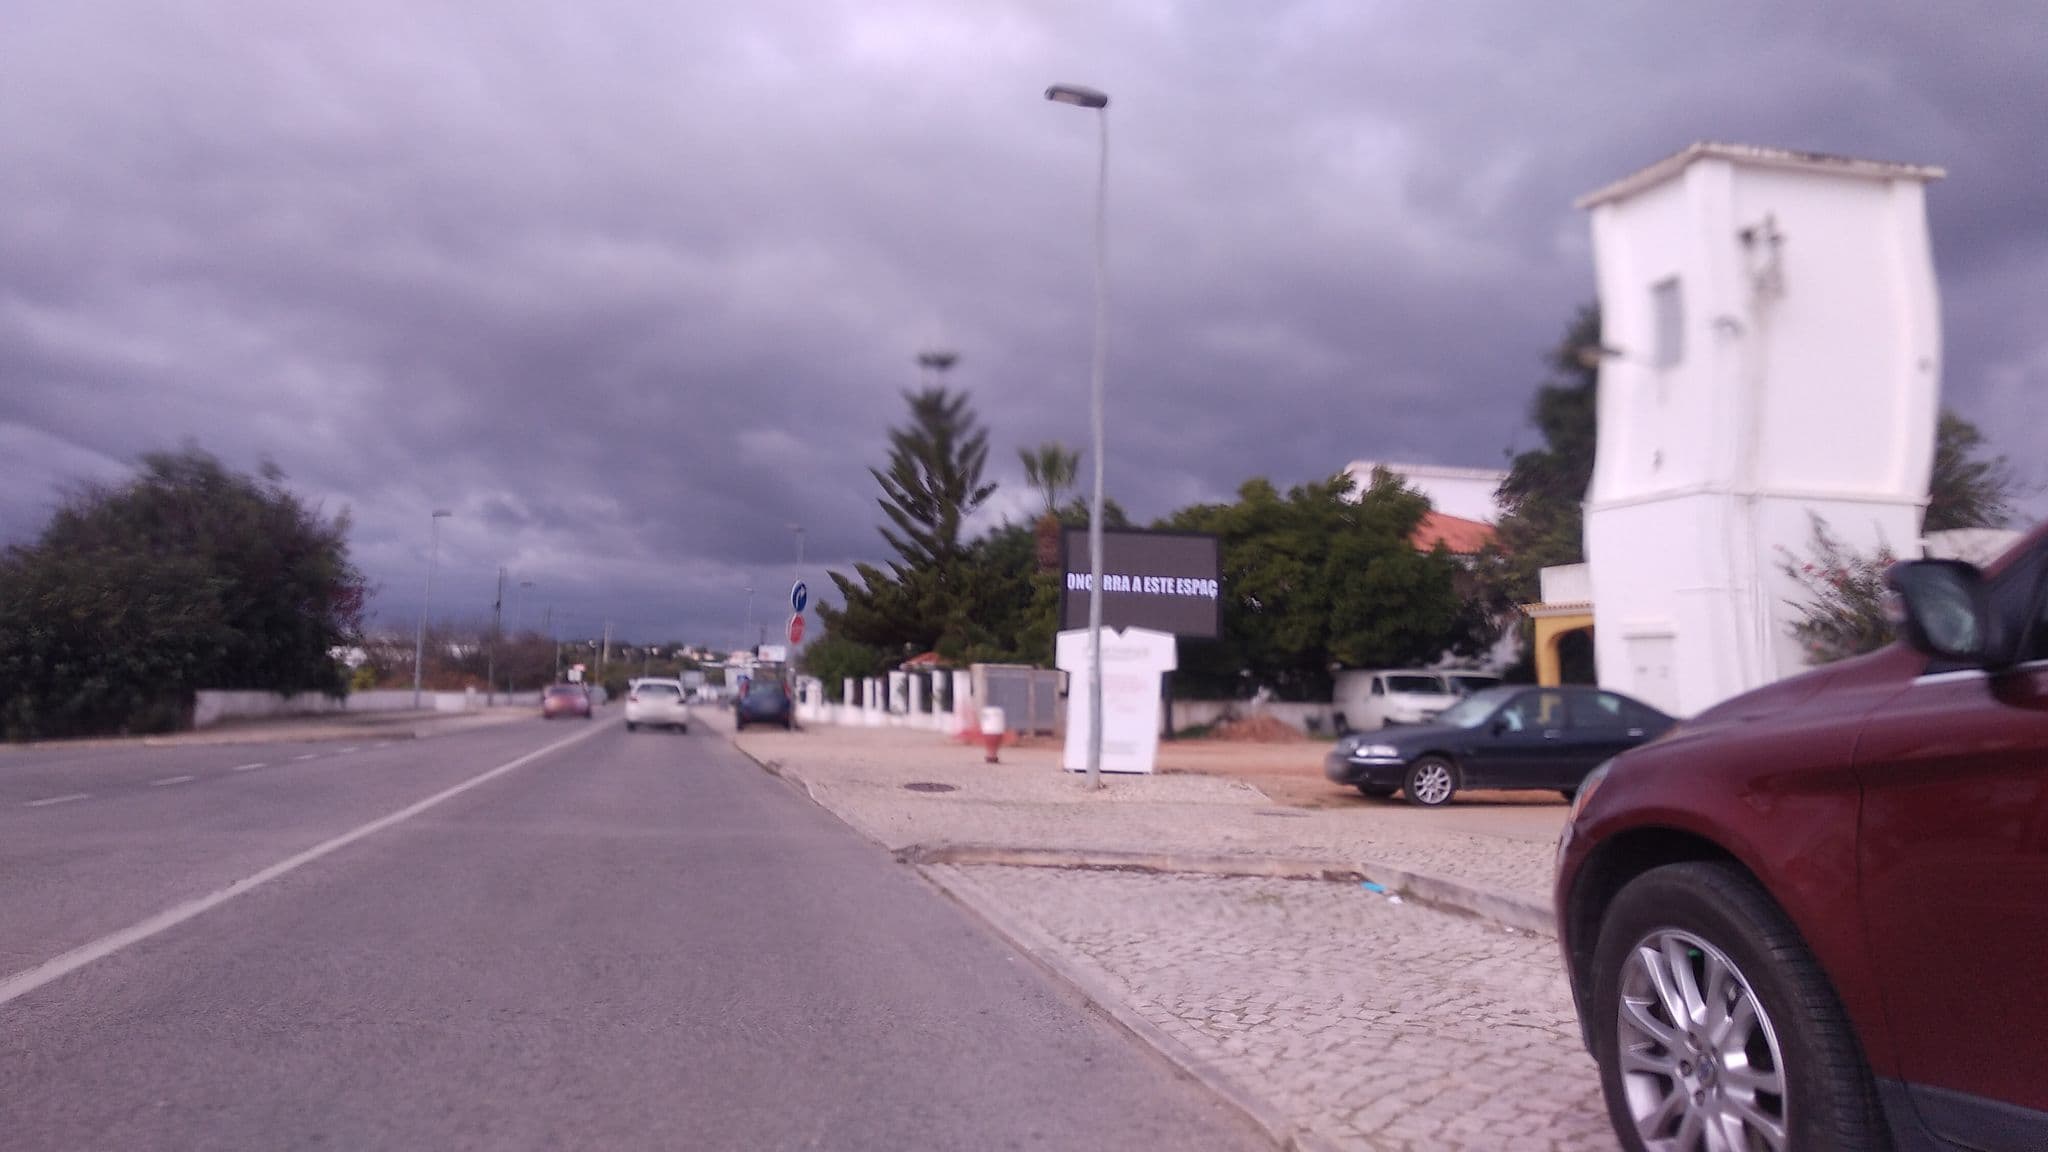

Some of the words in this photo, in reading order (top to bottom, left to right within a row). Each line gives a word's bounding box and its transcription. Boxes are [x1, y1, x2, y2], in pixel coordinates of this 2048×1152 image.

[1067, 573, 1130, 592] ONCRRA
[1132, 575, 1142, 592] A
[1143, 576, 1175, 594] ESTE
[1176, 578, 1218, 599] ESPAÇ
